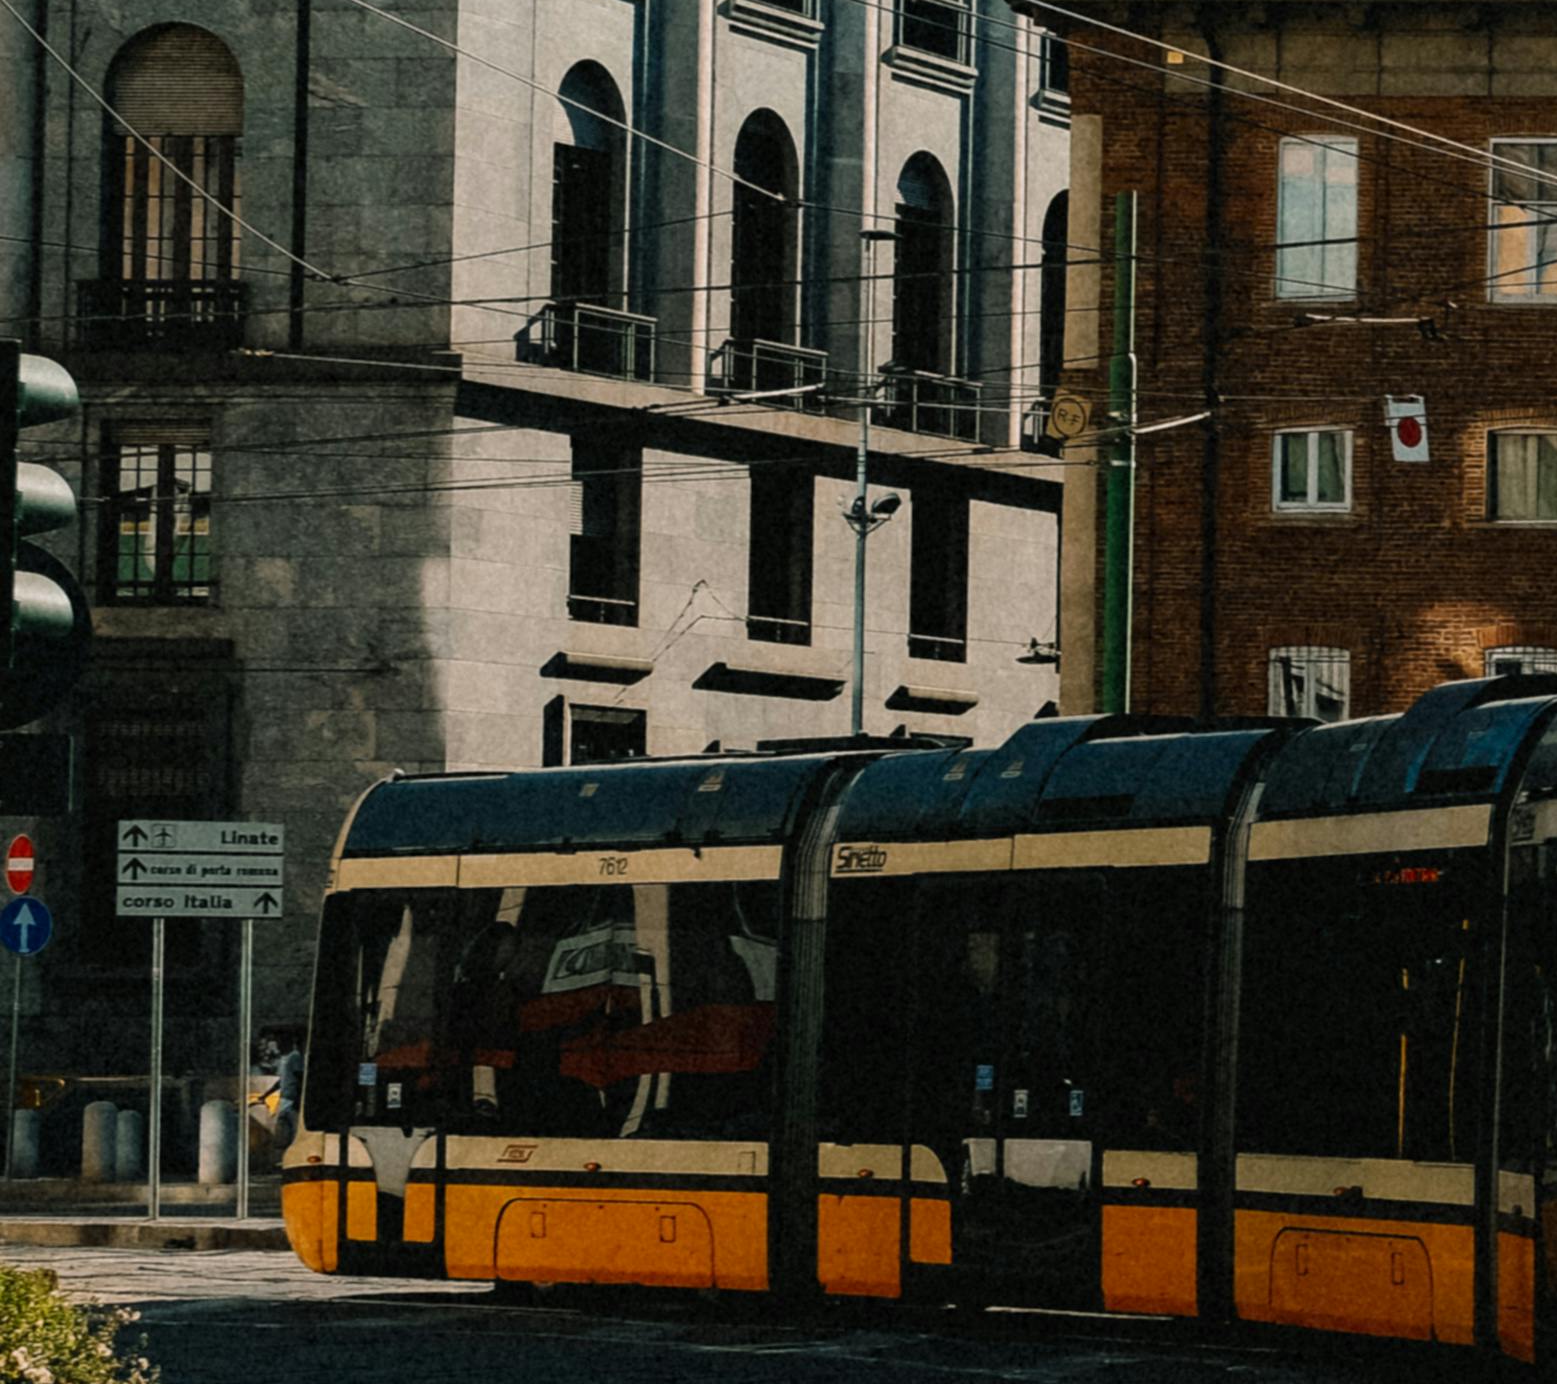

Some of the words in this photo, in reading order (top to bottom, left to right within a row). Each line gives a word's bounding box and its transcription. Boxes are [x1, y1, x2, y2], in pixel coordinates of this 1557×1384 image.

[221, 830, 279, 845] Linate
[599, 856, 629, 875] 7612
[122, 896, 175, 908] corso
[184, 894, 233, 909] Italia
